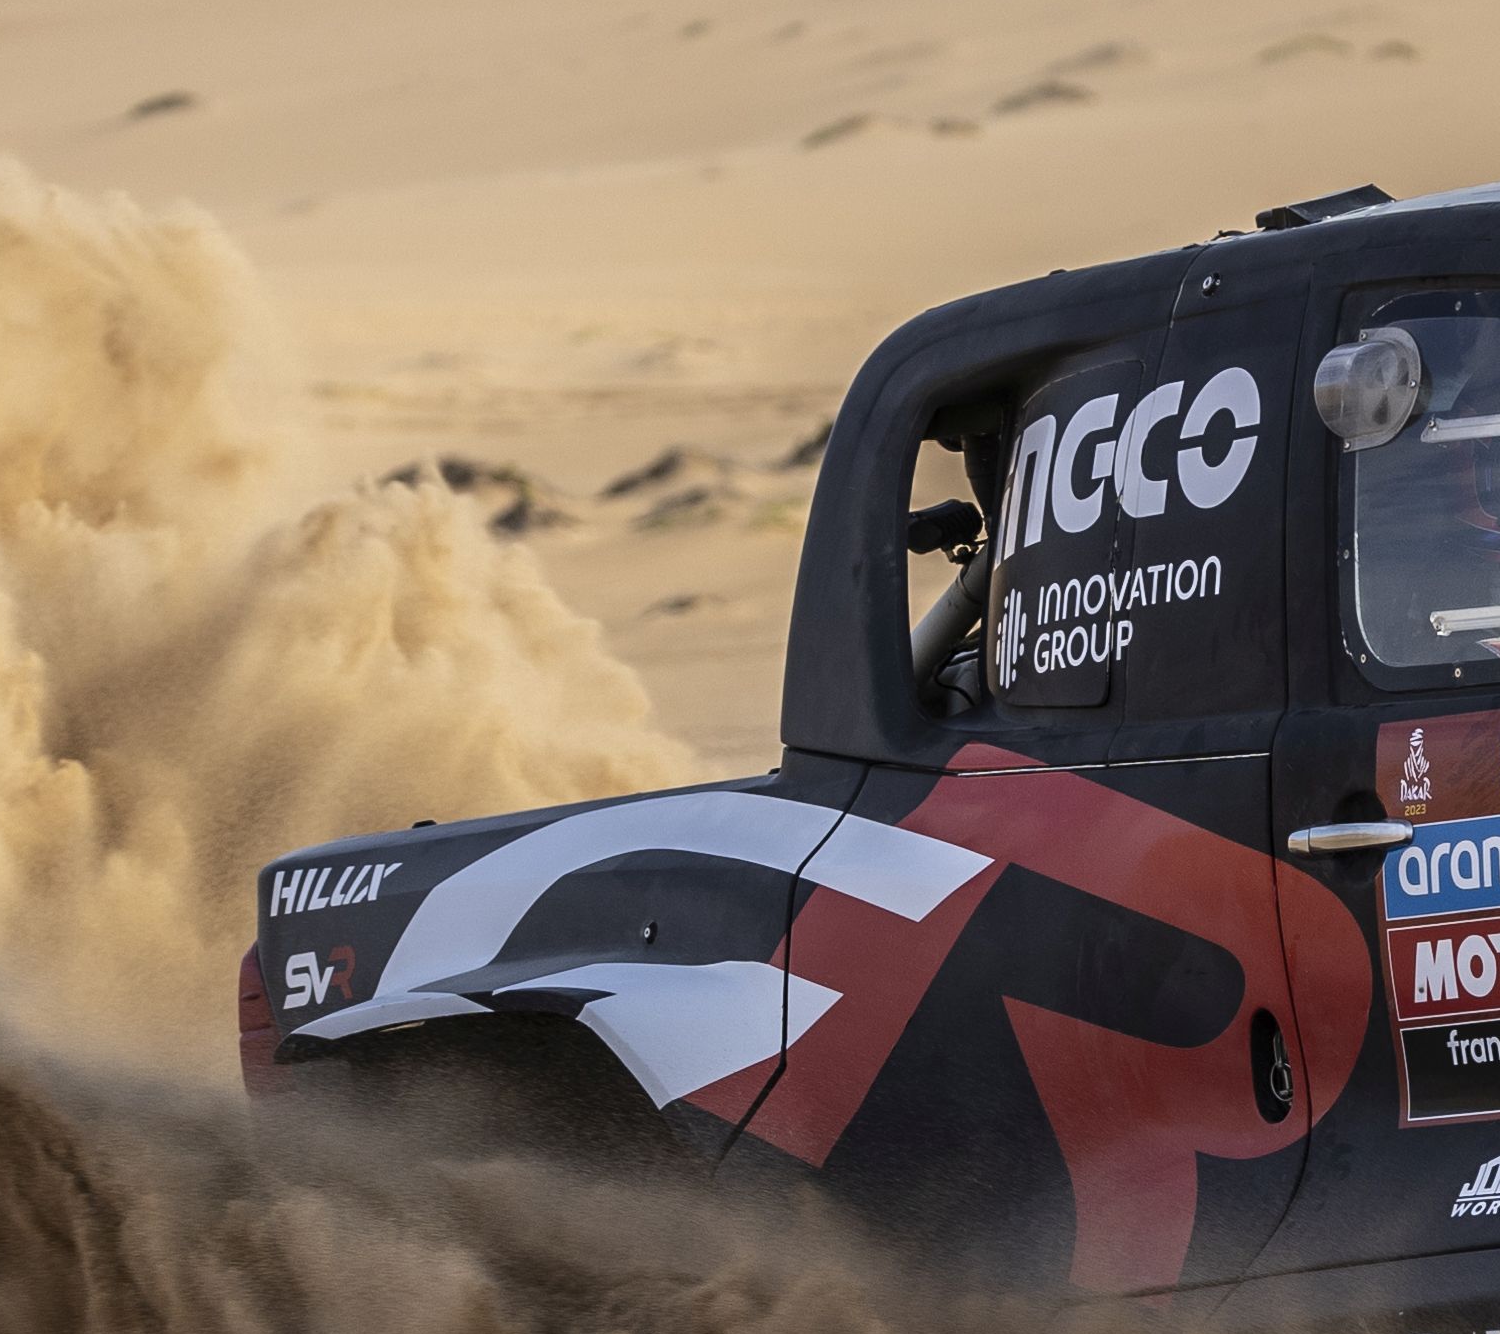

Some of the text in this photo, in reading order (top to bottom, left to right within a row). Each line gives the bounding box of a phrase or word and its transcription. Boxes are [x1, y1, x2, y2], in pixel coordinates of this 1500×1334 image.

[1037, 555, 1222, 625] INNOVATION
[1033, 620, 1133, 674] GROUP
[1404, 804, 1426, 816] 2023
[270, 862, 403, 916] HILUX
[282, 946, 356, 1009] SVR
